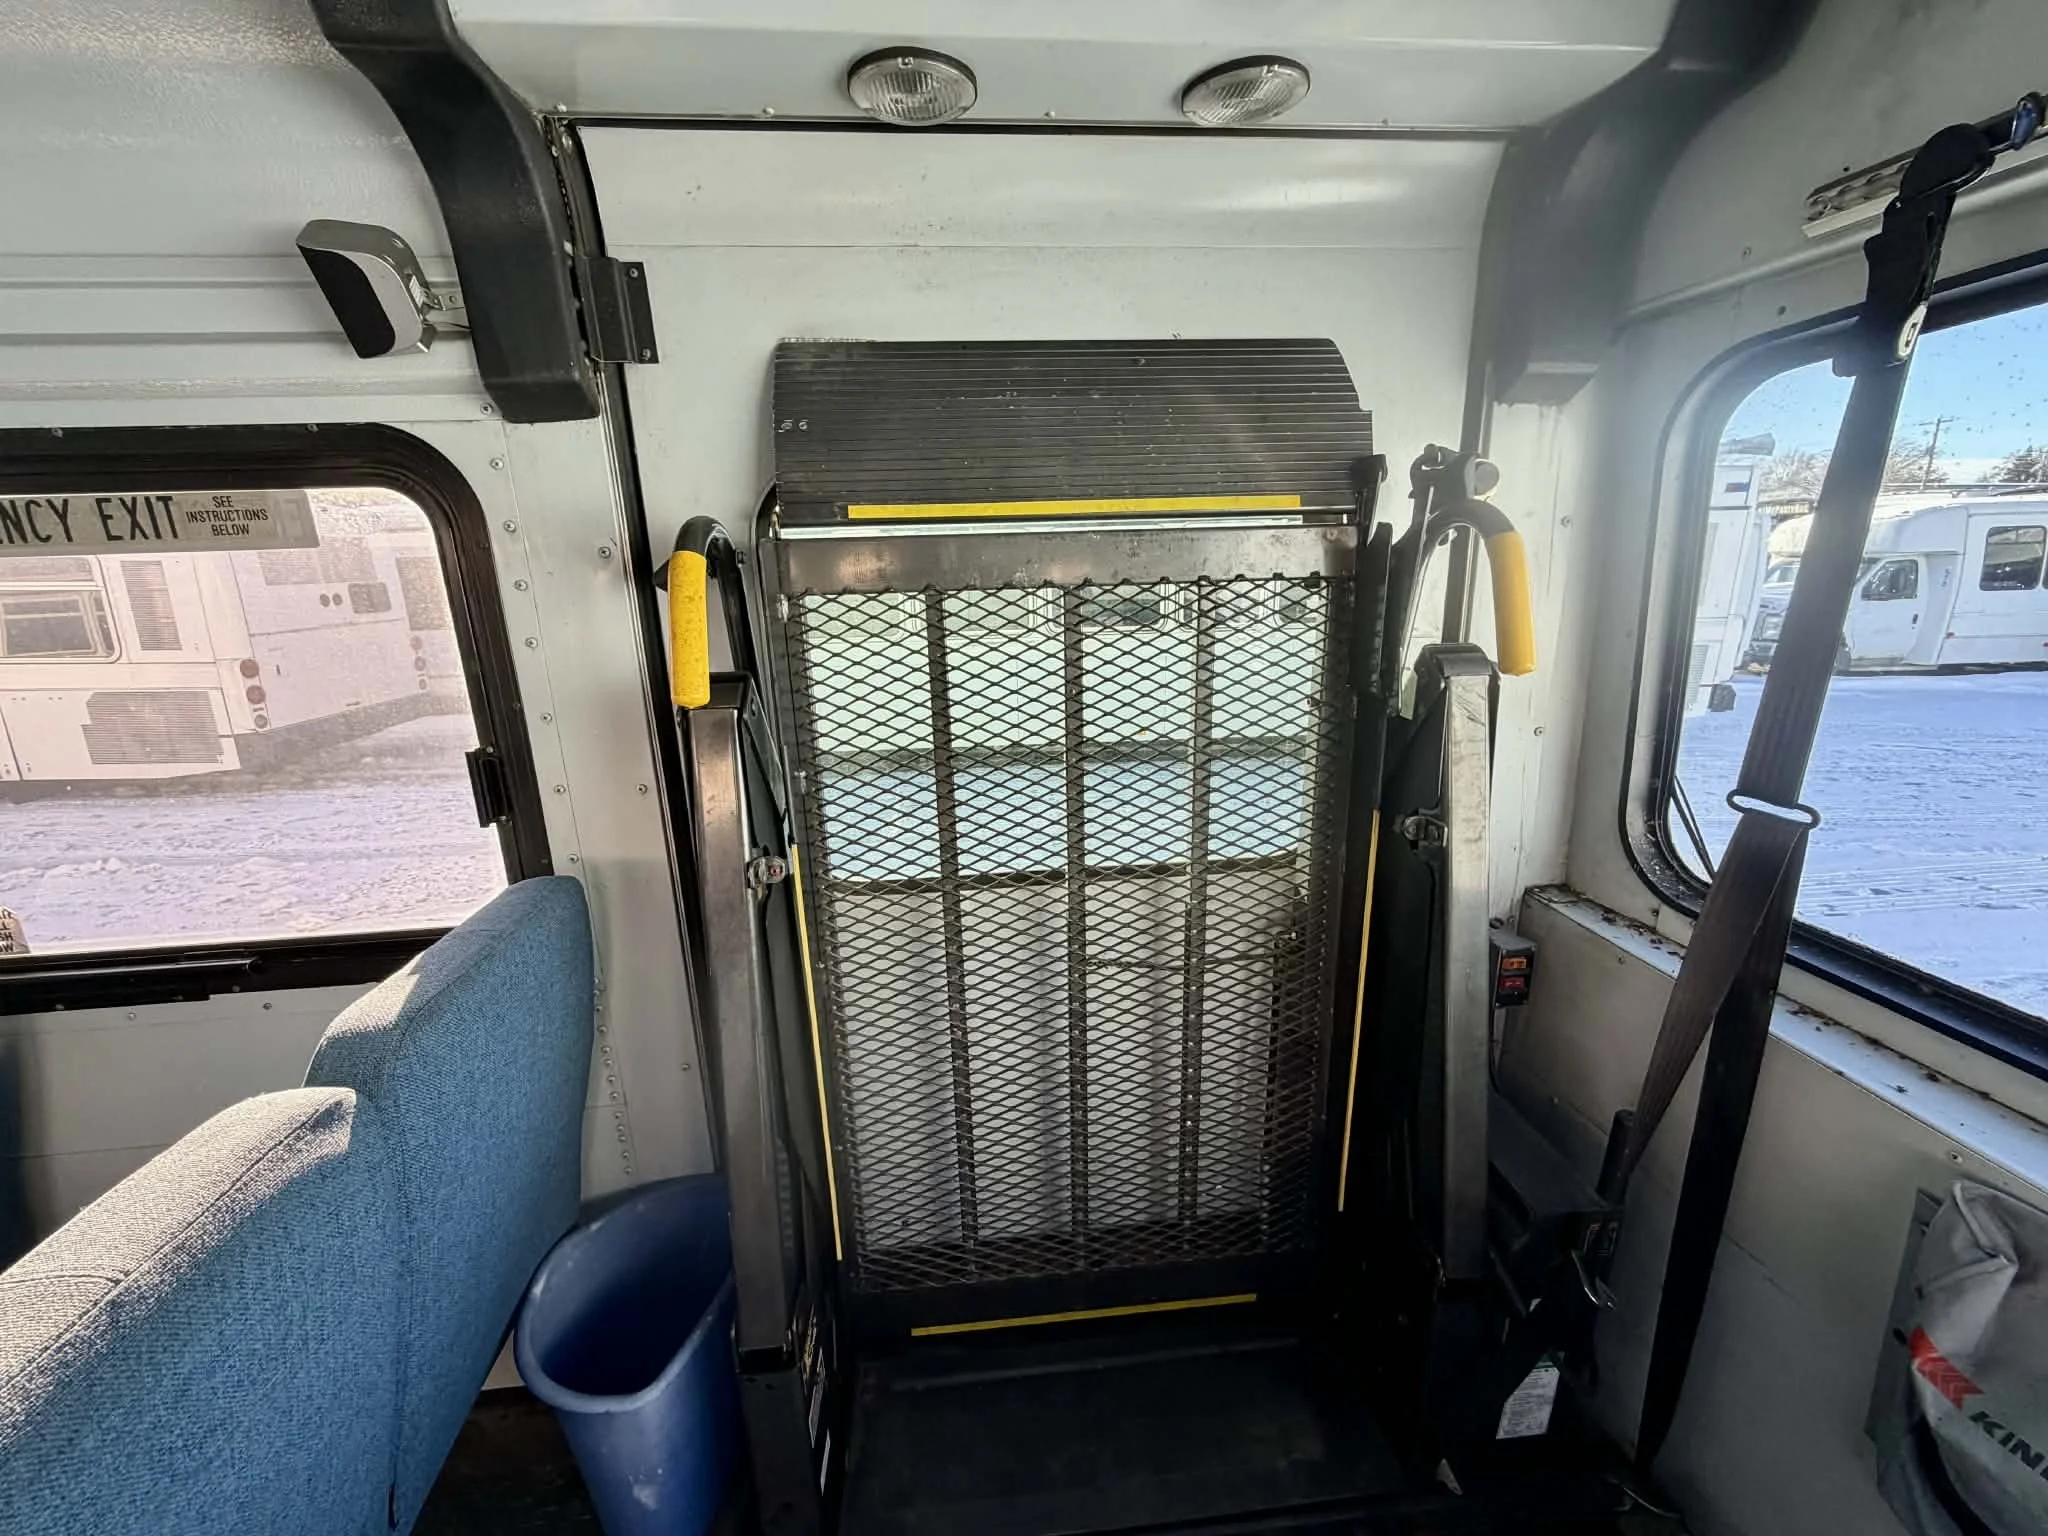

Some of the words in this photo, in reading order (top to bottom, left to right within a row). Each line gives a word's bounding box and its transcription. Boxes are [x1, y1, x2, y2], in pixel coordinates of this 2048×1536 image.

[211, 495, 234, 508] SEE
[0, 498, 73, 545] NCY
[95, 495, 179, 541] EXIT
[185, 508, 269, 523] INSTRUCTIONS
[211, 523, 251, 537] BELOW
[1968, 1411, 2048, 1481] KIN
